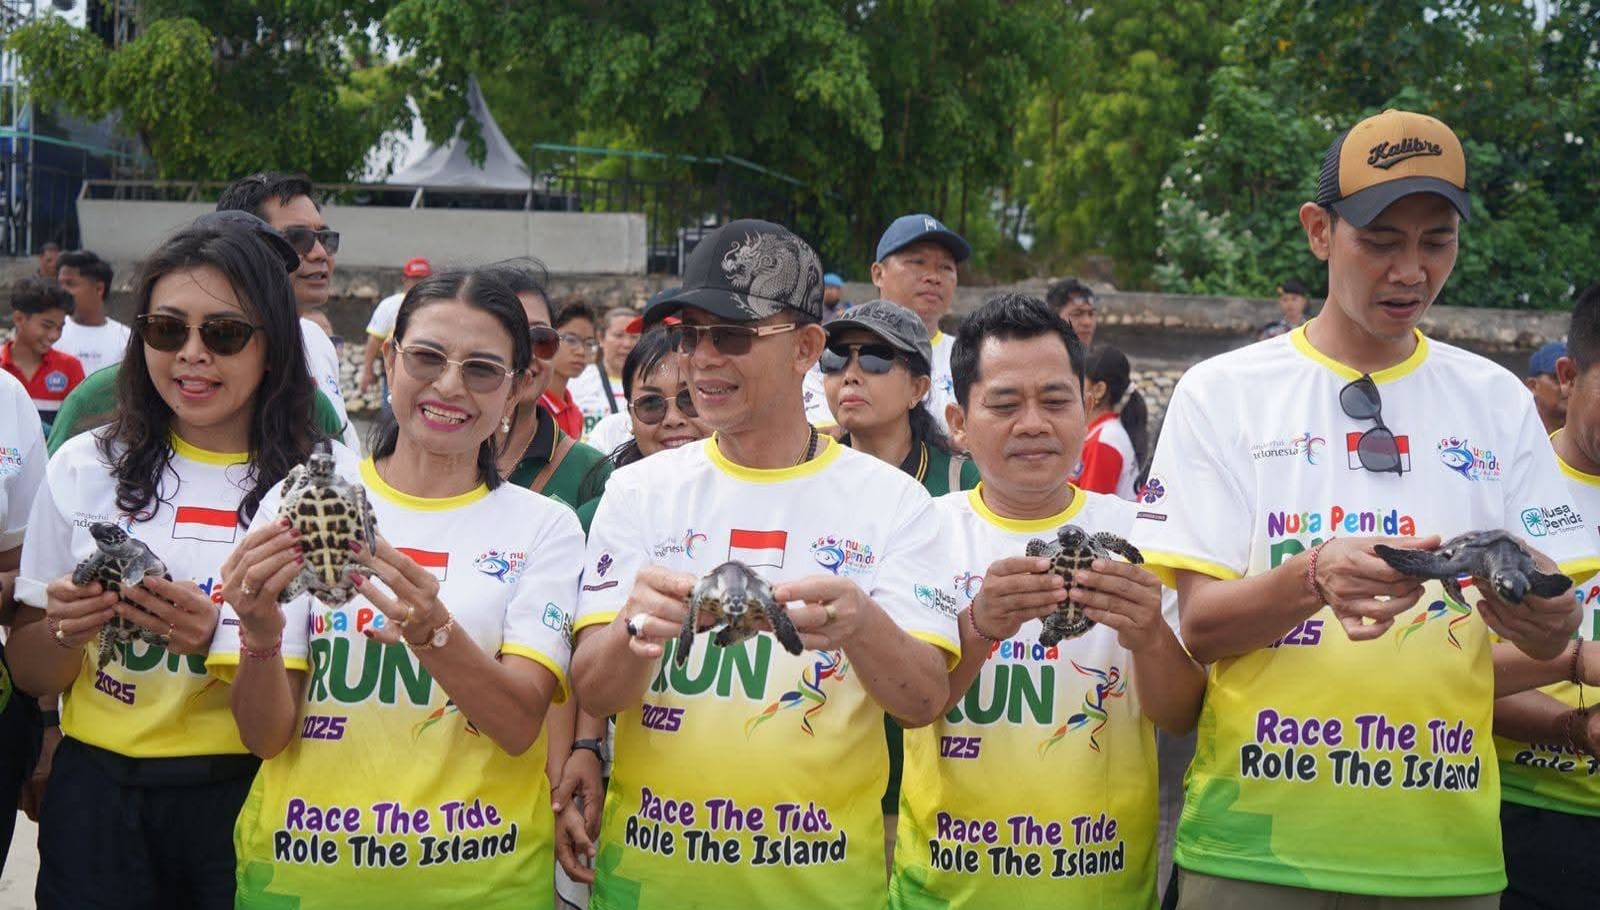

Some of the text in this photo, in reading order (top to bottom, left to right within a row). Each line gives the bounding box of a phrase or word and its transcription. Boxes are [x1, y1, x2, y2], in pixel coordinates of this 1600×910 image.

[1367, 138, 1443, 165] Kalibre
[1267, 505, 1416, 538] Nusa Penida
[1540, 504, 1571, 518] Nusa
[934, 587, 957, 605] Nusa
[935, 597, 959, 617] Peni
[95, 669, 137, 706] 2025
[308, 637, 433, 706] RUN
[945, 664, 1055, 725] UN
[301, 715, 348, 740] 025
[641, 703, 685, 732] 2025
[1256, 709, 1474, 755] Race The Tide
[940, 735, 982, 760] 025
[1241, 744, 1480, 790] Role The Island
[286, 799, 502, 834] Race The Tide
[638, 787, 833, 833] Race The Tide
[274, 823, 517, 867] Role The Island
[625, 815, 847, 866] Role The Island
[936, 812, 1118, 846] Race The Tide
[929, 839, 1124, 877] Role The Island
